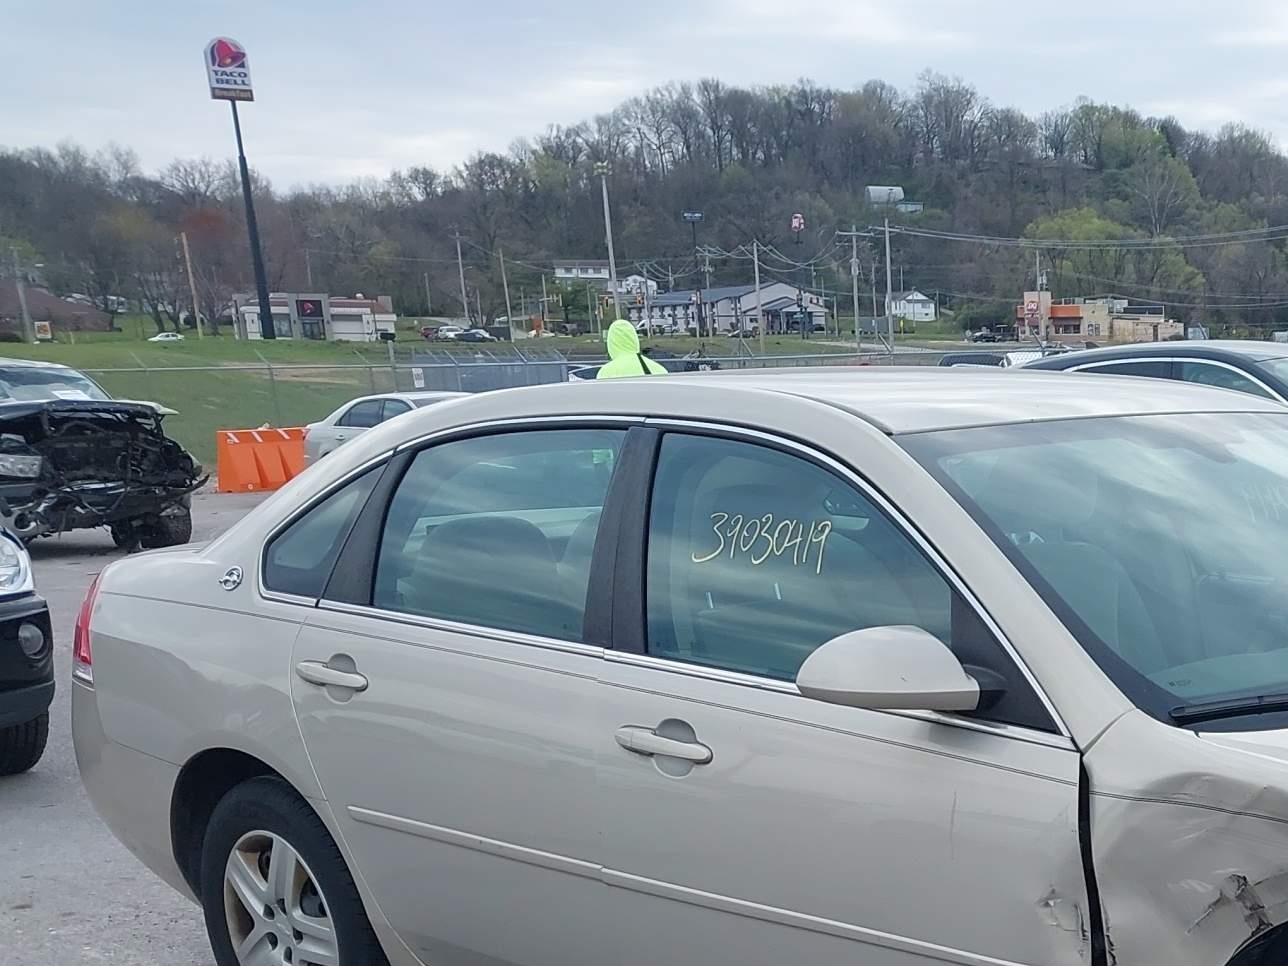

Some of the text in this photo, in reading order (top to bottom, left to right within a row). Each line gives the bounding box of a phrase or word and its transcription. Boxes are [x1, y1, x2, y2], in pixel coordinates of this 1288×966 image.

[212, 70, 247, 78] TACO
[215, 78, 248, 86] BELL
[691, 512, 833, 574] 39030419
